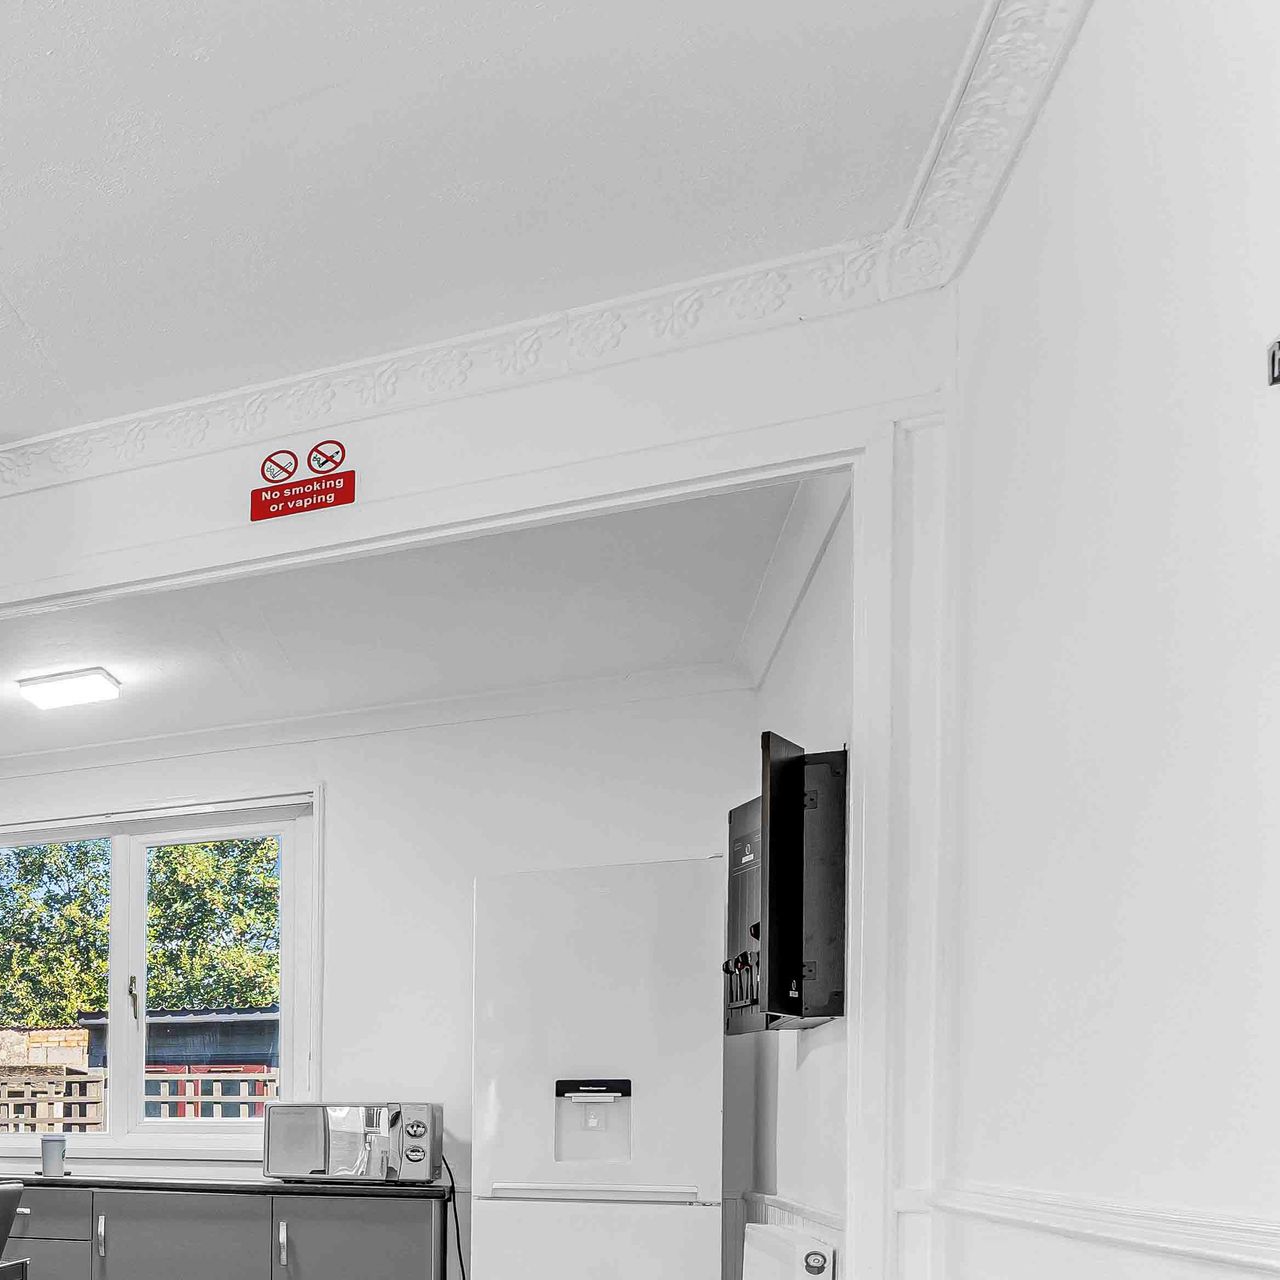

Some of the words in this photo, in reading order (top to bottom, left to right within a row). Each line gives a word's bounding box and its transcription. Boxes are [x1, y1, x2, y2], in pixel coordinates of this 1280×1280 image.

[261, 491, 280, 501] No
[283, 477, 344, 496] smoking
[269, 503, 284, 512] or
[287, 492, 335, 509] vaping
